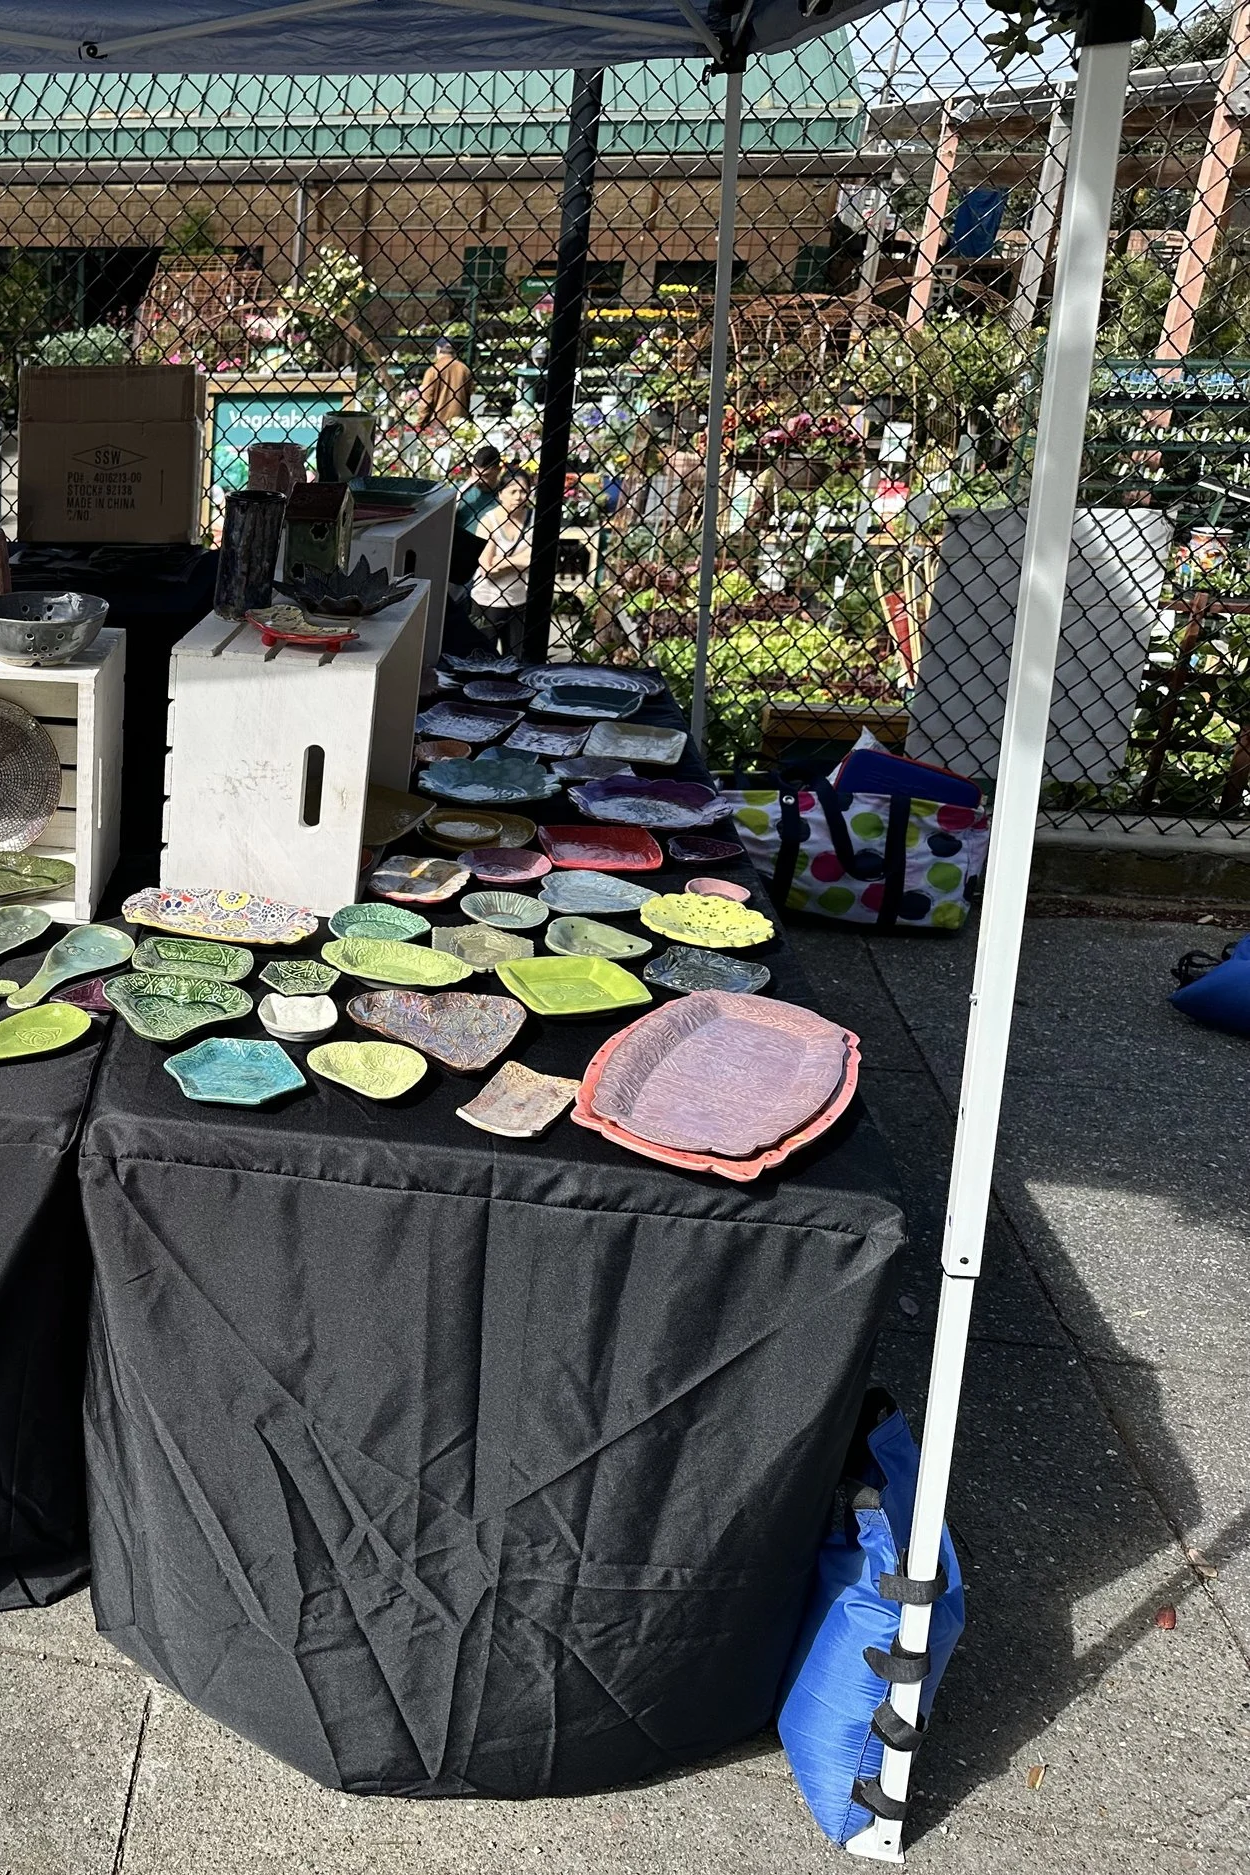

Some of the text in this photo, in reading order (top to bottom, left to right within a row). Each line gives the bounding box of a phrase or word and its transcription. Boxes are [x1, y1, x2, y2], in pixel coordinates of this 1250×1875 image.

[229, 408, 324, 432] Vegetables
[95, 450, 121, 464] SSW
[67, 484, 102, 496] STOCK#
[67, 497, 135, 509] MADE IN CHINA
